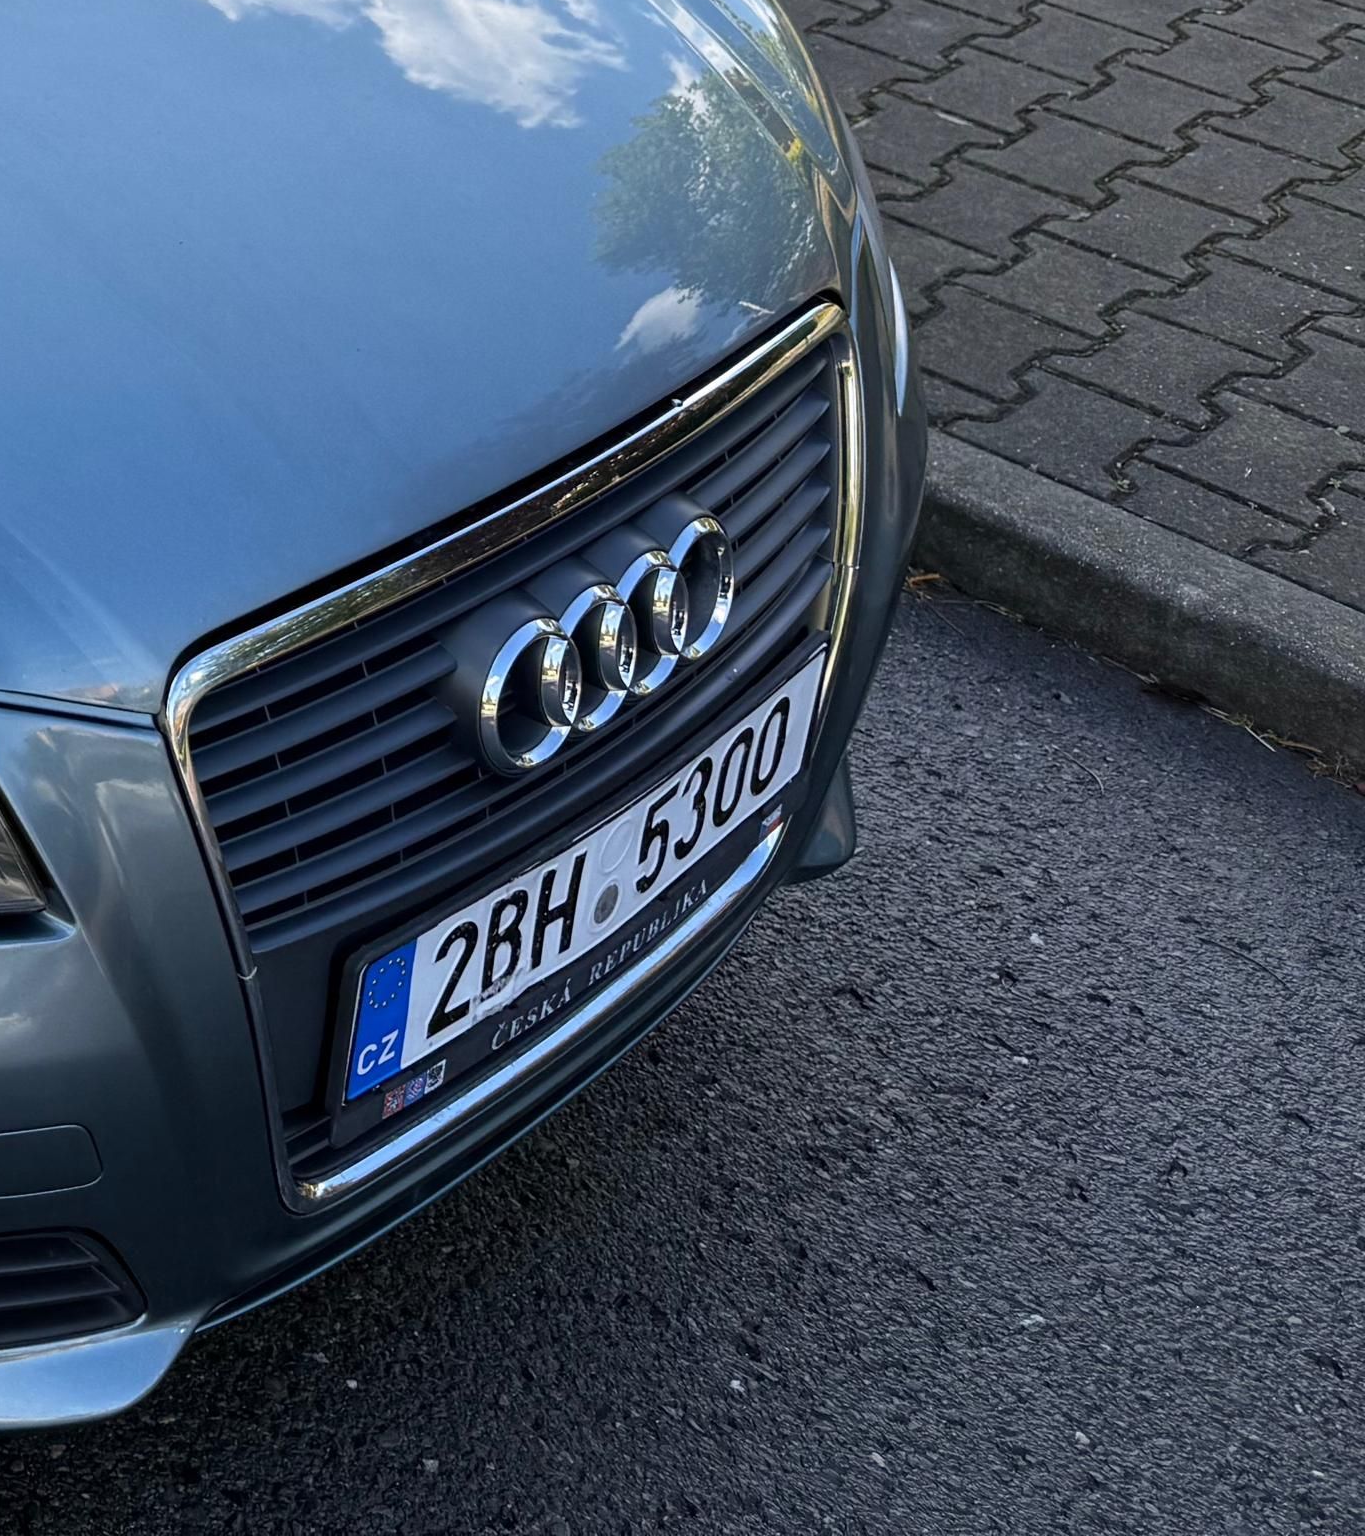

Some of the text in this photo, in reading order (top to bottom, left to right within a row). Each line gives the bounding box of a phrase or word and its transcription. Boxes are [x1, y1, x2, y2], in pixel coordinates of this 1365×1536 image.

[427, 695, 791, 1041] 2BH 5300
[491, 977, 572, 1050] ČESKÁ
[356, 1028, 399, 1076] CZ
